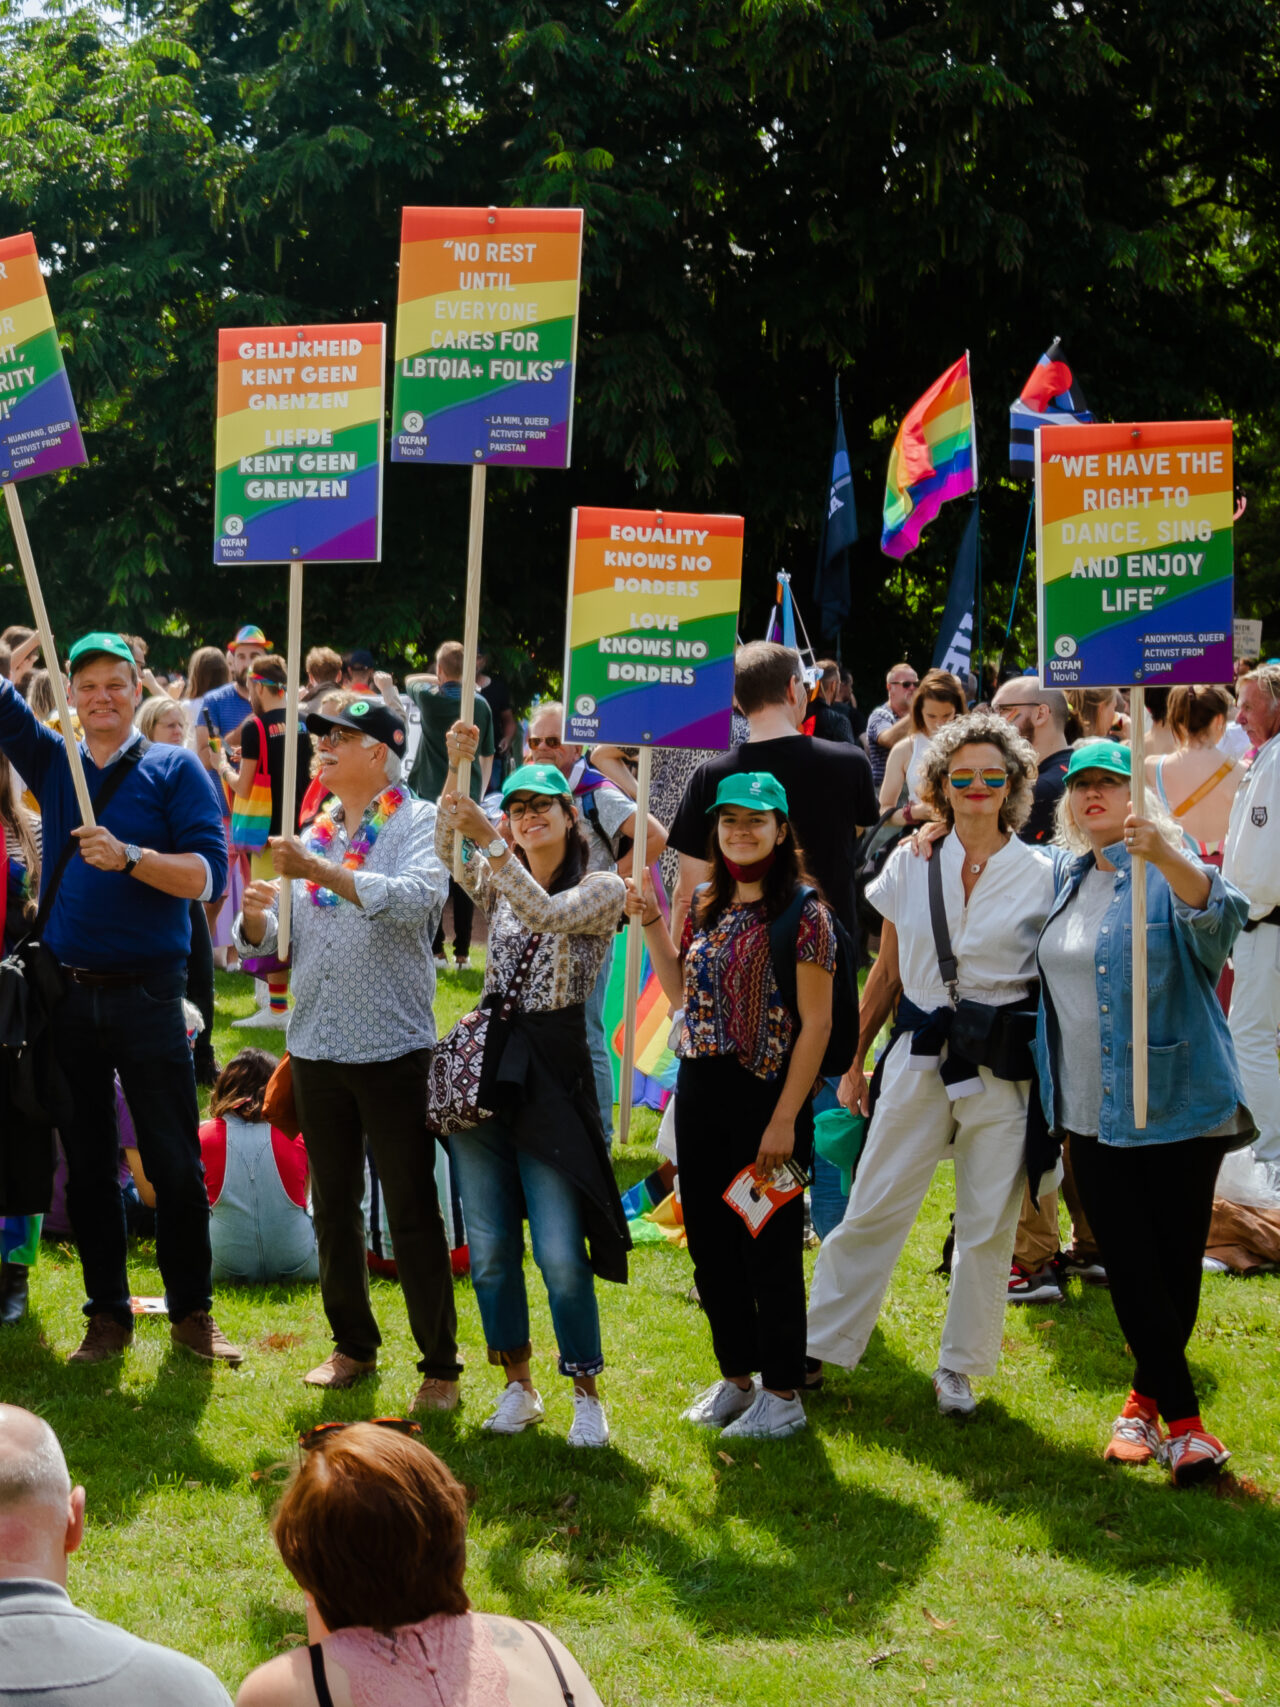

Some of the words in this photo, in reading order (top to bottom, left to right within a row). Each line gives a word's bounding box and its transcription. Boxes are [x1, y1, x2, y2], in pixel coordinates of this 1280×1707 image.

[443, 241, 480, 262] “NO
[486, 243, 537, 262] REST
[460, 272, 516, 291] UNTIL
[435, 301, 538, 321] EVERYONE
[239, 339, 362, 359] GELIJKHEID
[431, 330, 495, 351] CARES
[501, 332, 538, 351] FOR
[241, 368, 295, 385] KENT
[301, 366, 357, 383] GEEN
[402, 358, 484, 379] LBTQIA+
[490, 360, 564, 381] FOLKS”
[249, 392, 348, 410] GRENZEN
[48, 422, 71, 433] QUEER
[492, 416, 501, 424] LA
[524, 417, 549, 425] QUEER
[265, 429, 332, 446] LIEFDE
[399, 435, 427, 445] OXFAM
[491, 430, 523, 438] ACTIVIST
[525, 431, 546, 439] FROM
[11, 442, 41, 456] ACTIVIST
[42, 437, 61, 448] FROM
[401, 446, 424, 456] Novib
[490, 443, 526, 452] PAKISTAN
[14, 457, 35, 468] CHINA
[240, 456, 294, 473] KENT
[299, 454, 355, 472] GEEN
[1049, 454, 1099, 478] “WE
[1107, 453, 1170, 476] HAVE
[1177, 451, 1223, 473] THE
[246, 480, 347, 498] GRENZEN
[1083, 487, 1153, 511] RIGHT
[1160, 486, 1189, 508] TO
[610, 525, 709, 545] EQUALITY
[1062, 521, 1148, 545] DANCE,
[1157, 520, 1212, 542] SING
[221, 538, 247, 547] OXFAM
[223, 548, 244, 556] Novib
[604, 551, 677, 571] KNOWS
[681, 556, 712, 571] NO
[1070, 556, 1119, 579] AND
[1127, 553, 1203, 577] ENJOY
[614, 578, 698, 597] BORDERS
[1102, 587, 1165, 612] LIFE”
[630, 613, 679, 631] LOVE
[1145, 634, 1196, 643] ANONYMOUS,
[1199, 633, 1224, 642] QUEER
[599, 637, 672, 657] KNOWS
[676, 642, 707, 658] NO
[1145, 648, 1179, 657] ACTIVIST
[1181, 648, 1204, 656] FROM
[608, 664, 694, 684] BORDERS
[1050, 661, 1081, 670] OXFAM
[1145, 663, 1171, 671] SUDAN
[1053, 671, 1078, 681] Novib
[571, 718, 599, 727] OXFAM
[573, 728, 595, 737] Novib
